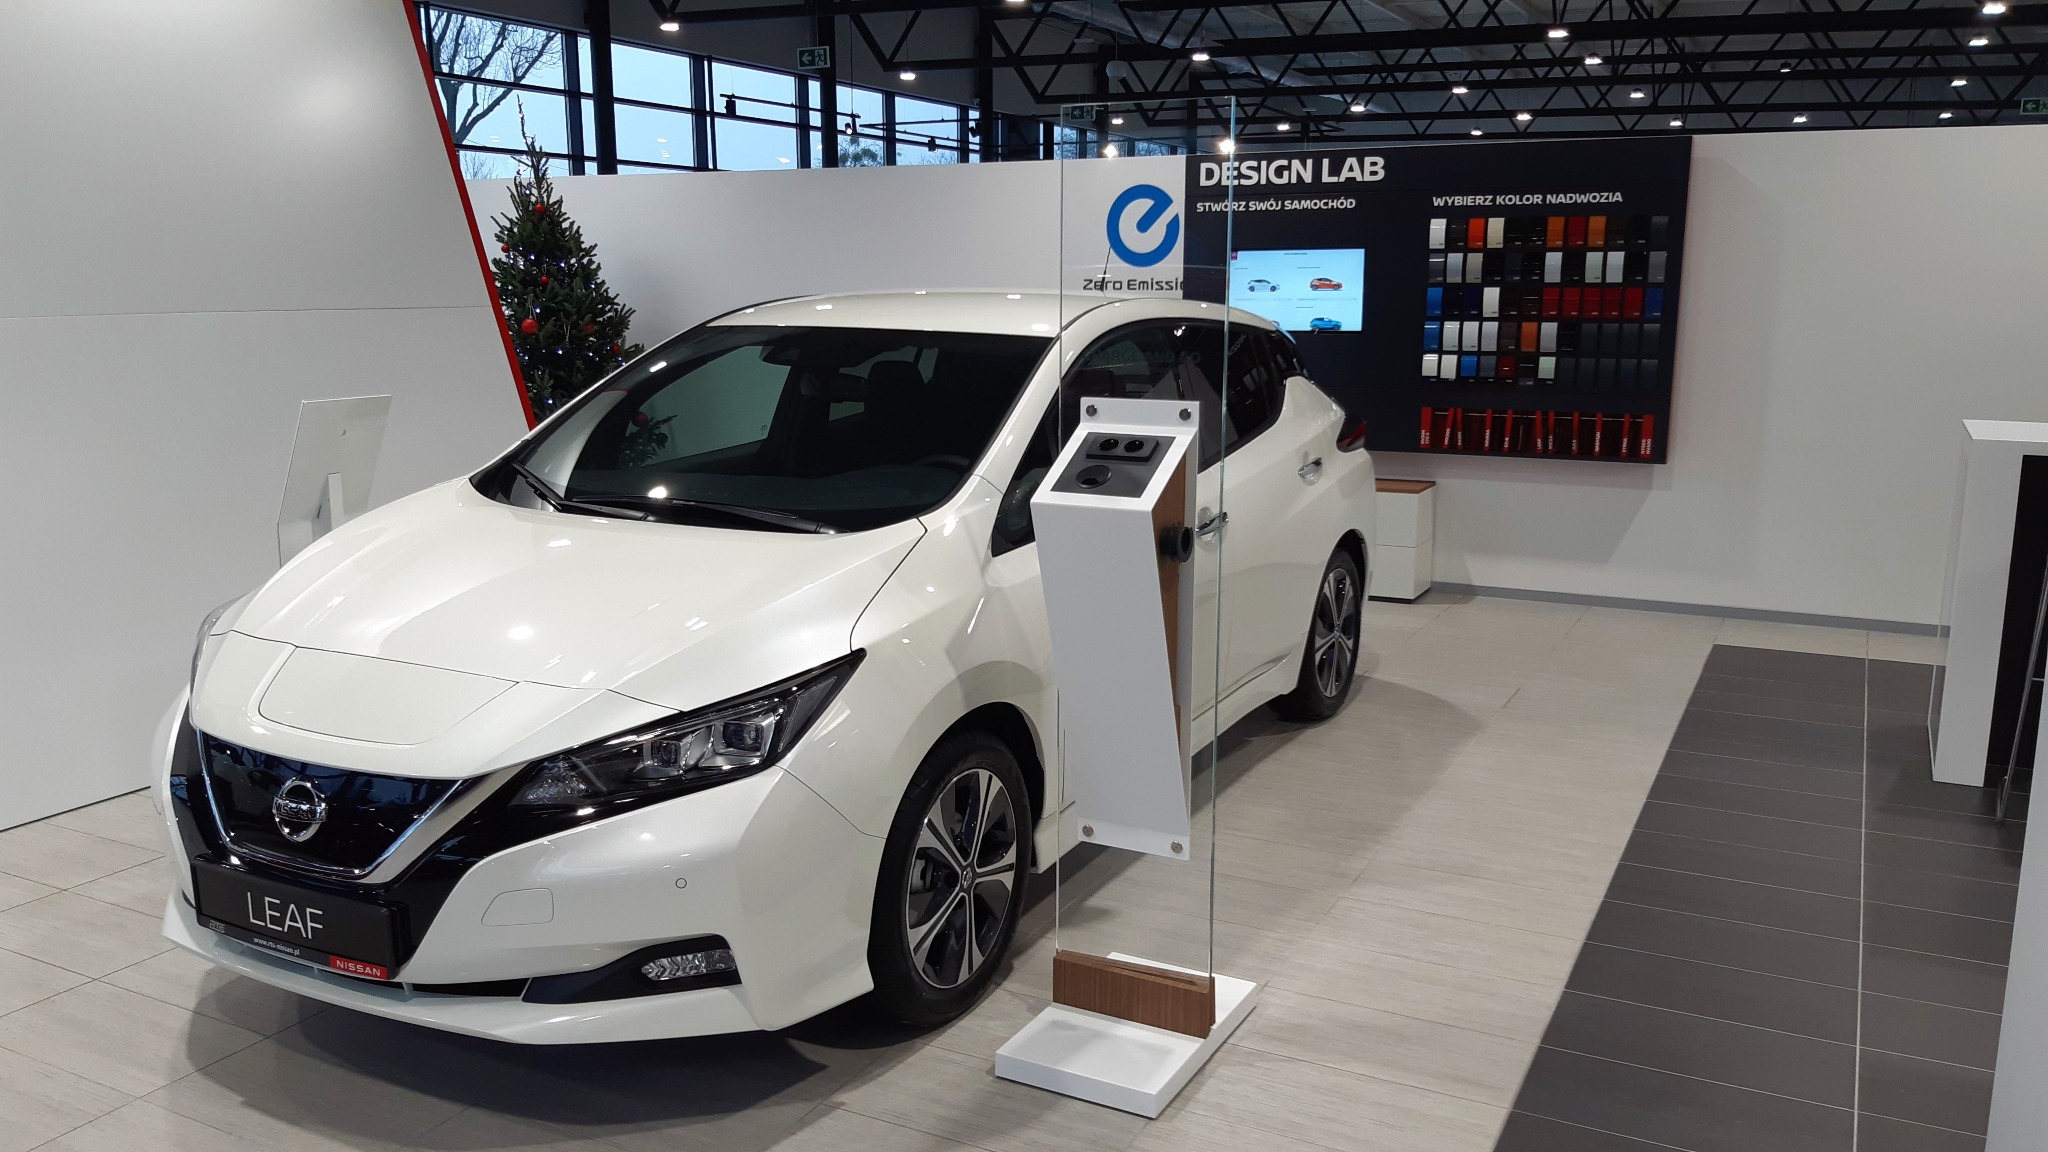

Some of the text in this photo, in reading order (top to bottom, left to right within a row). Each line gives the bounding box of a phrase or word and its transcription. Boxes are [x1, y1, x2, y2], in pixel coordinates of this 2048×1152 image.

[1200, 156, 1385, 187] DESIGN LAB
[1248, 198, 1282, 211] SWÓJ
[1284, 196, 1356, 210] SAMOCHÓD
[1432, 192, 1623, 207] WYBIERZ KOLOR NADWOZIA
[1083, 278, 1123, 291] Zero
[247, 891, 324, 940] LEAF
[336, 959, 381, 977] NISSAN
